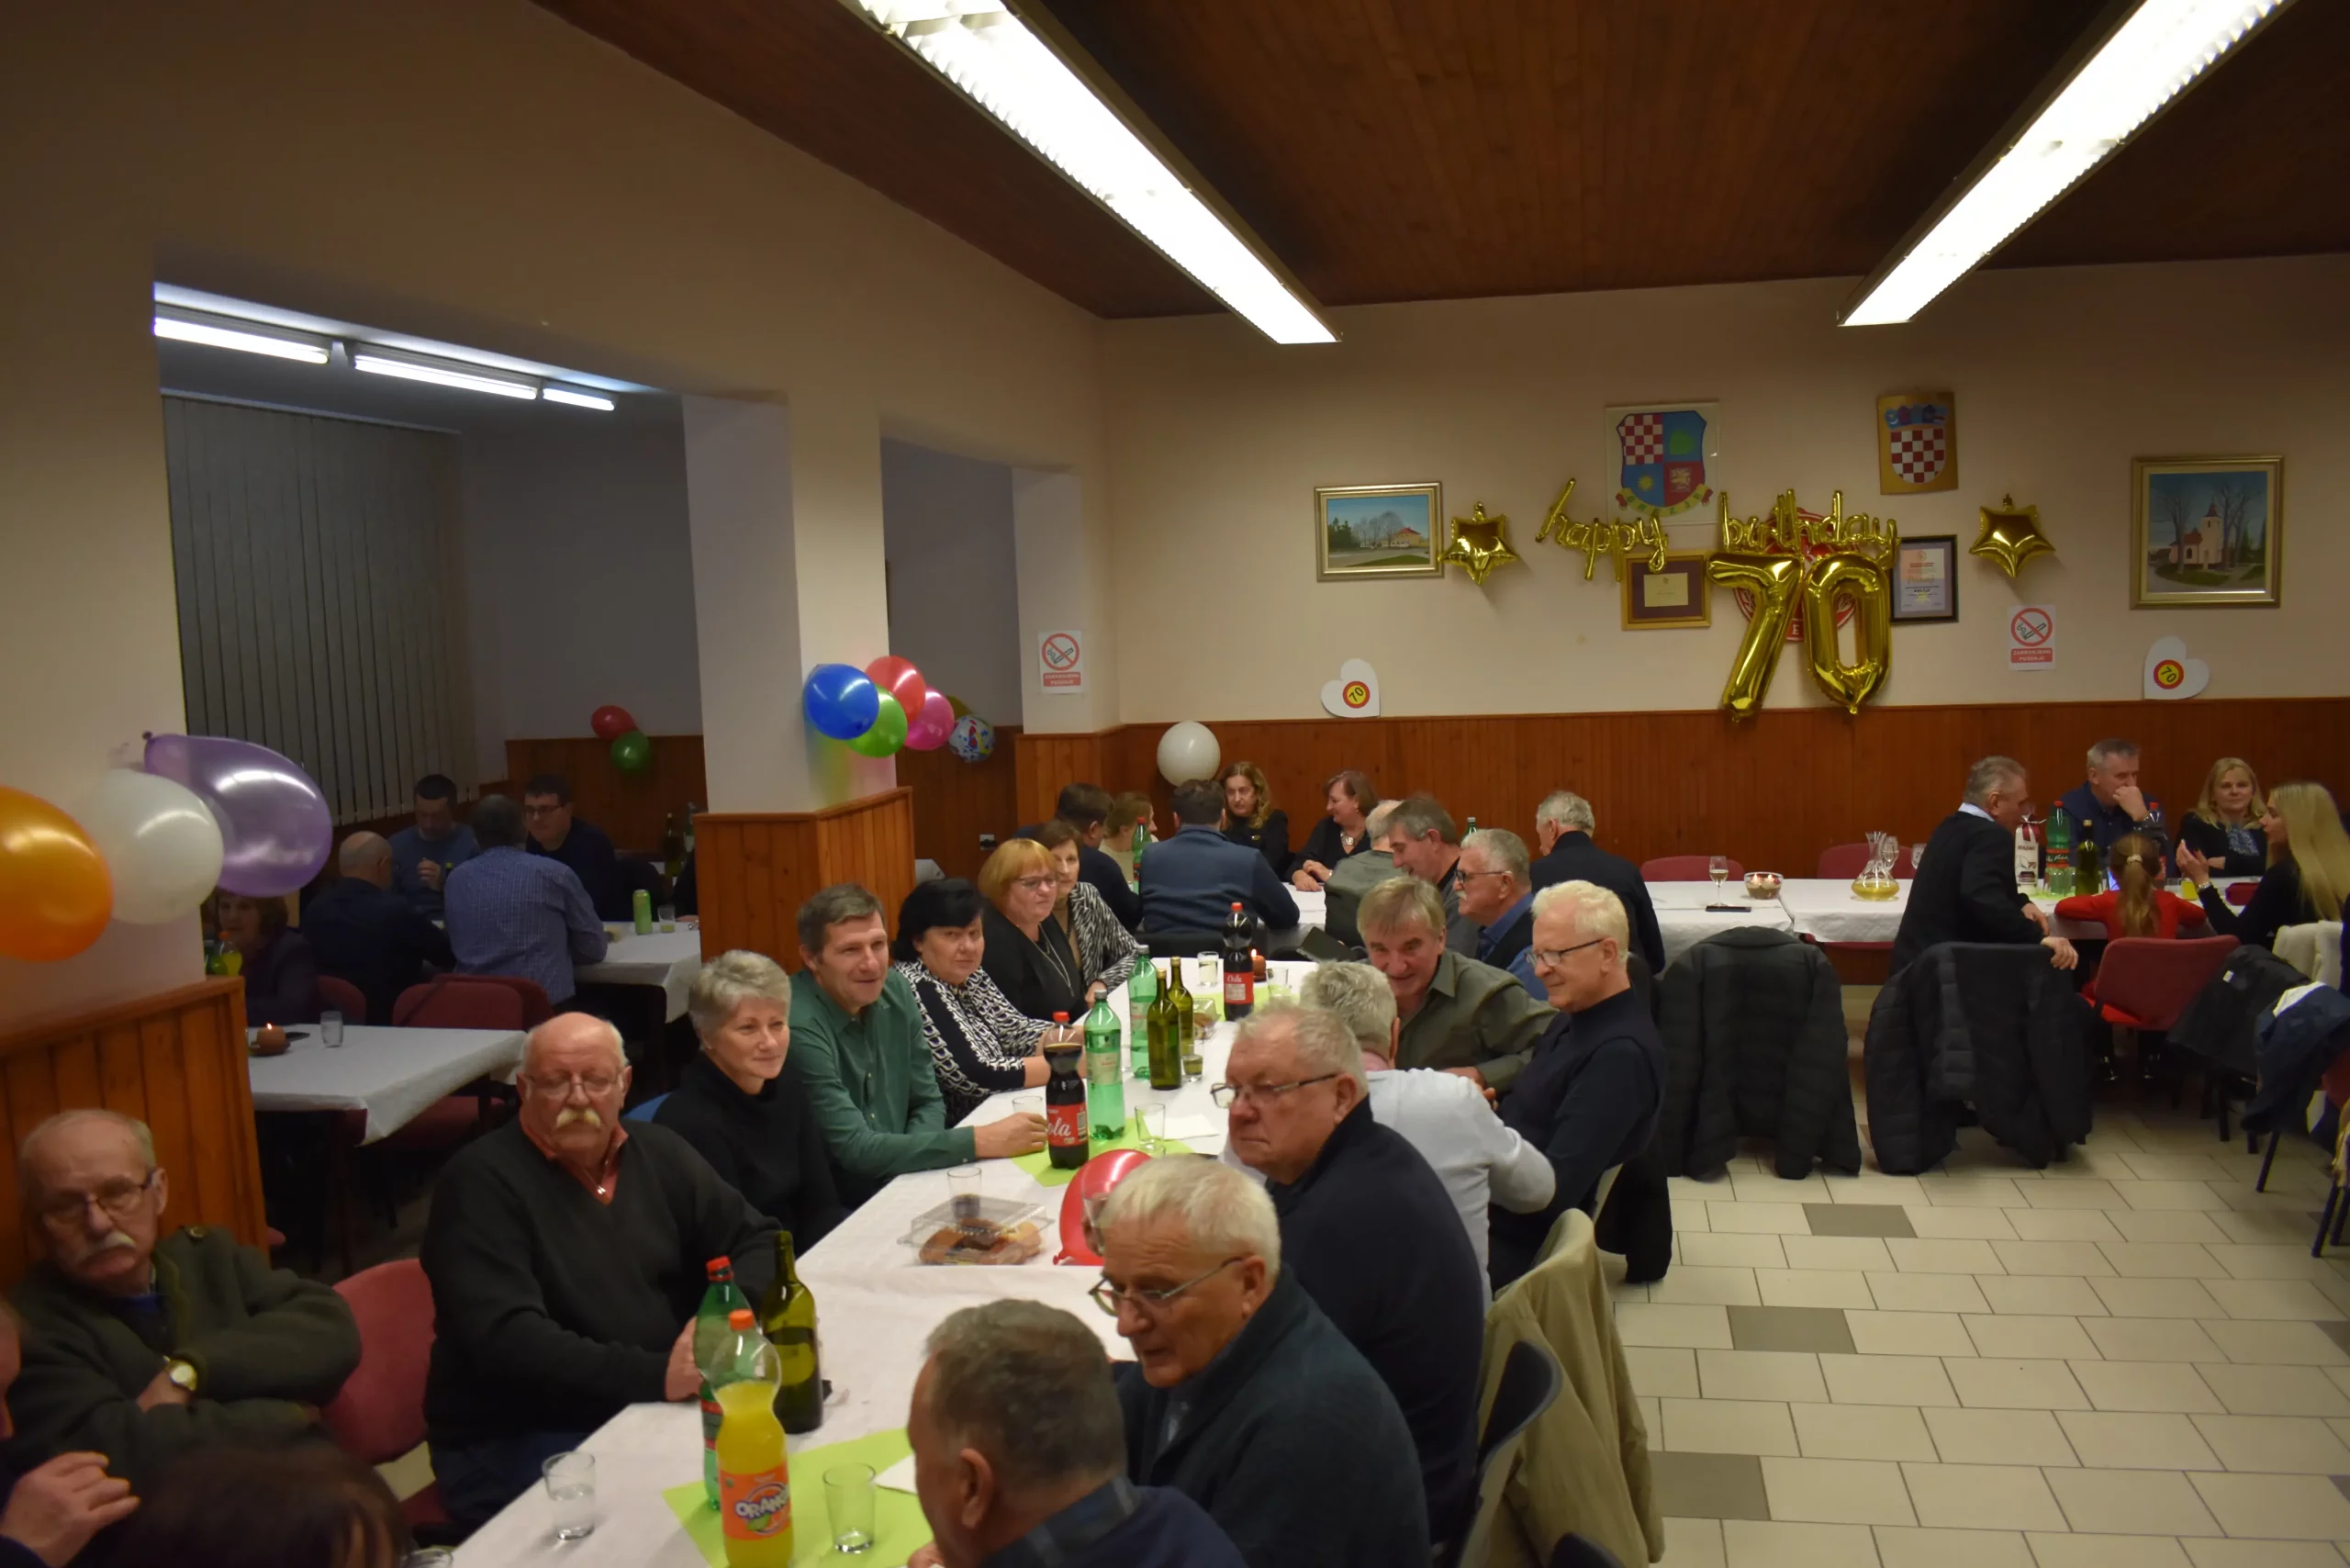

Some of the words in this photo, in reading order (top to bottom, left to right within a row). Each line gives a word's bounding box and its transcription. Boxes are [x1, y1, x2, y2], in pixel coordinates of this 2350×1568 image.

[1535, 477, 1668, 582] happy
[1719, 488, 1900, 570] birthday
[1706, 551, 1892, 721] 70
[2161, 666, 2177, 683] 70
[1348, 687, 1364, 701] 70
[1046, 1116, 1072, 1137] ola
